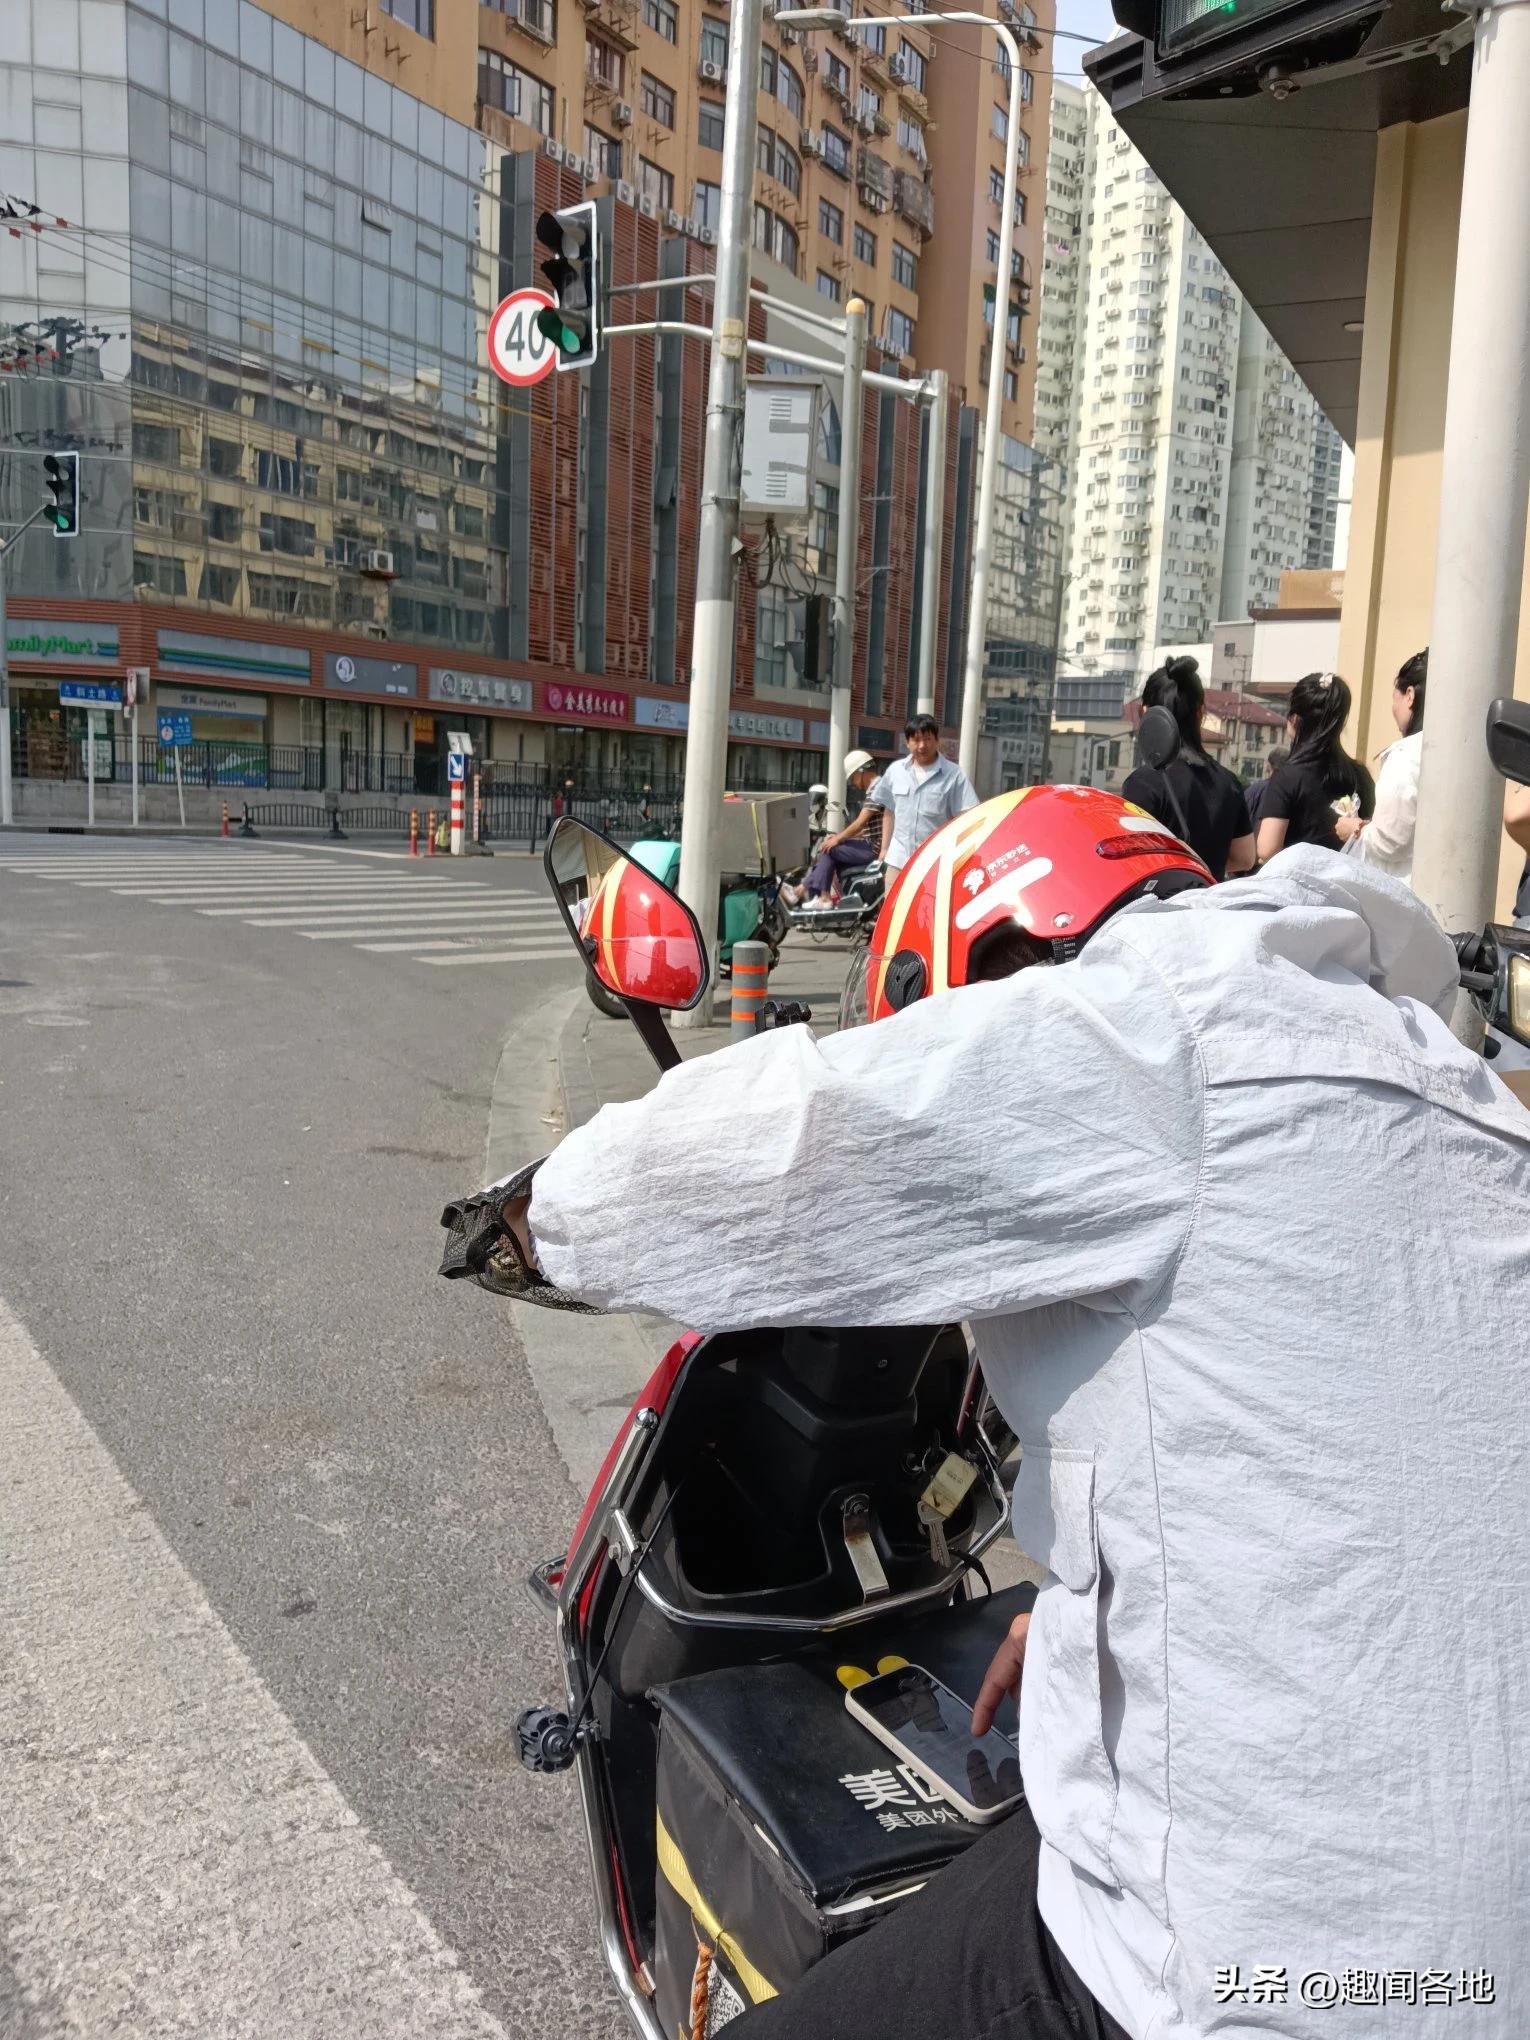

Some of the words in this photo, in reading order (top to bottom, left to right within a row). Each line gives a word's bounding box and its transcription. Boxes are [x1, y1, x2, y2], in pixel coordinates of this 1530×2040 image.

[505, 310, 546, 361] 40
[6, 634, 96, 656] amilyMart
[875, 1808, 973, 1832] 美团外
